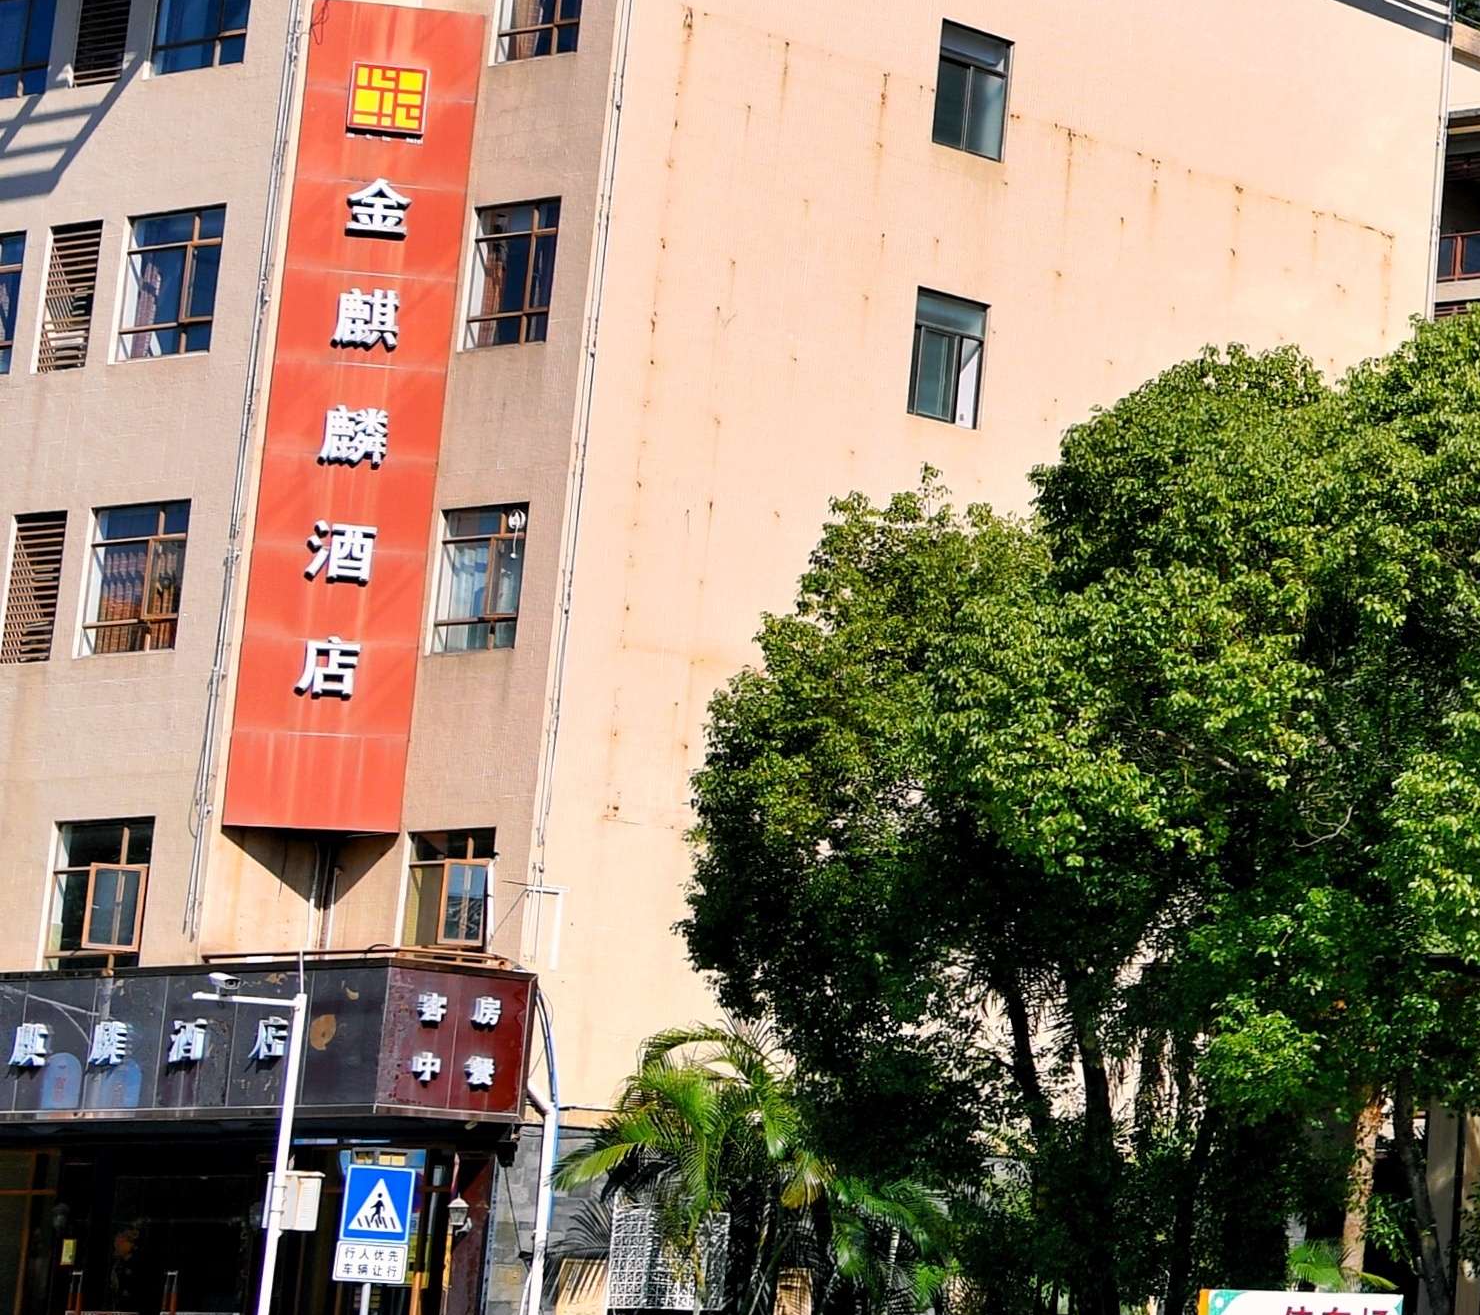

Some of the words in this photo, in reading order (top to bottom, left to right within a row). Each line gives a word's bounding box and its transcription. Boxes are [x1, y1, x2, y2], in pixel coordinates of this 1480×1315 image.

[294, 178, 411, 700] 金麒麟酒店
[417, 992, 501, 1027] 客房
[412, 1052, 495, 1087] 中餐
[342, 1263, 397, 1277] 车辆让行
[345, 1247, 398, 1262] 行人优先
